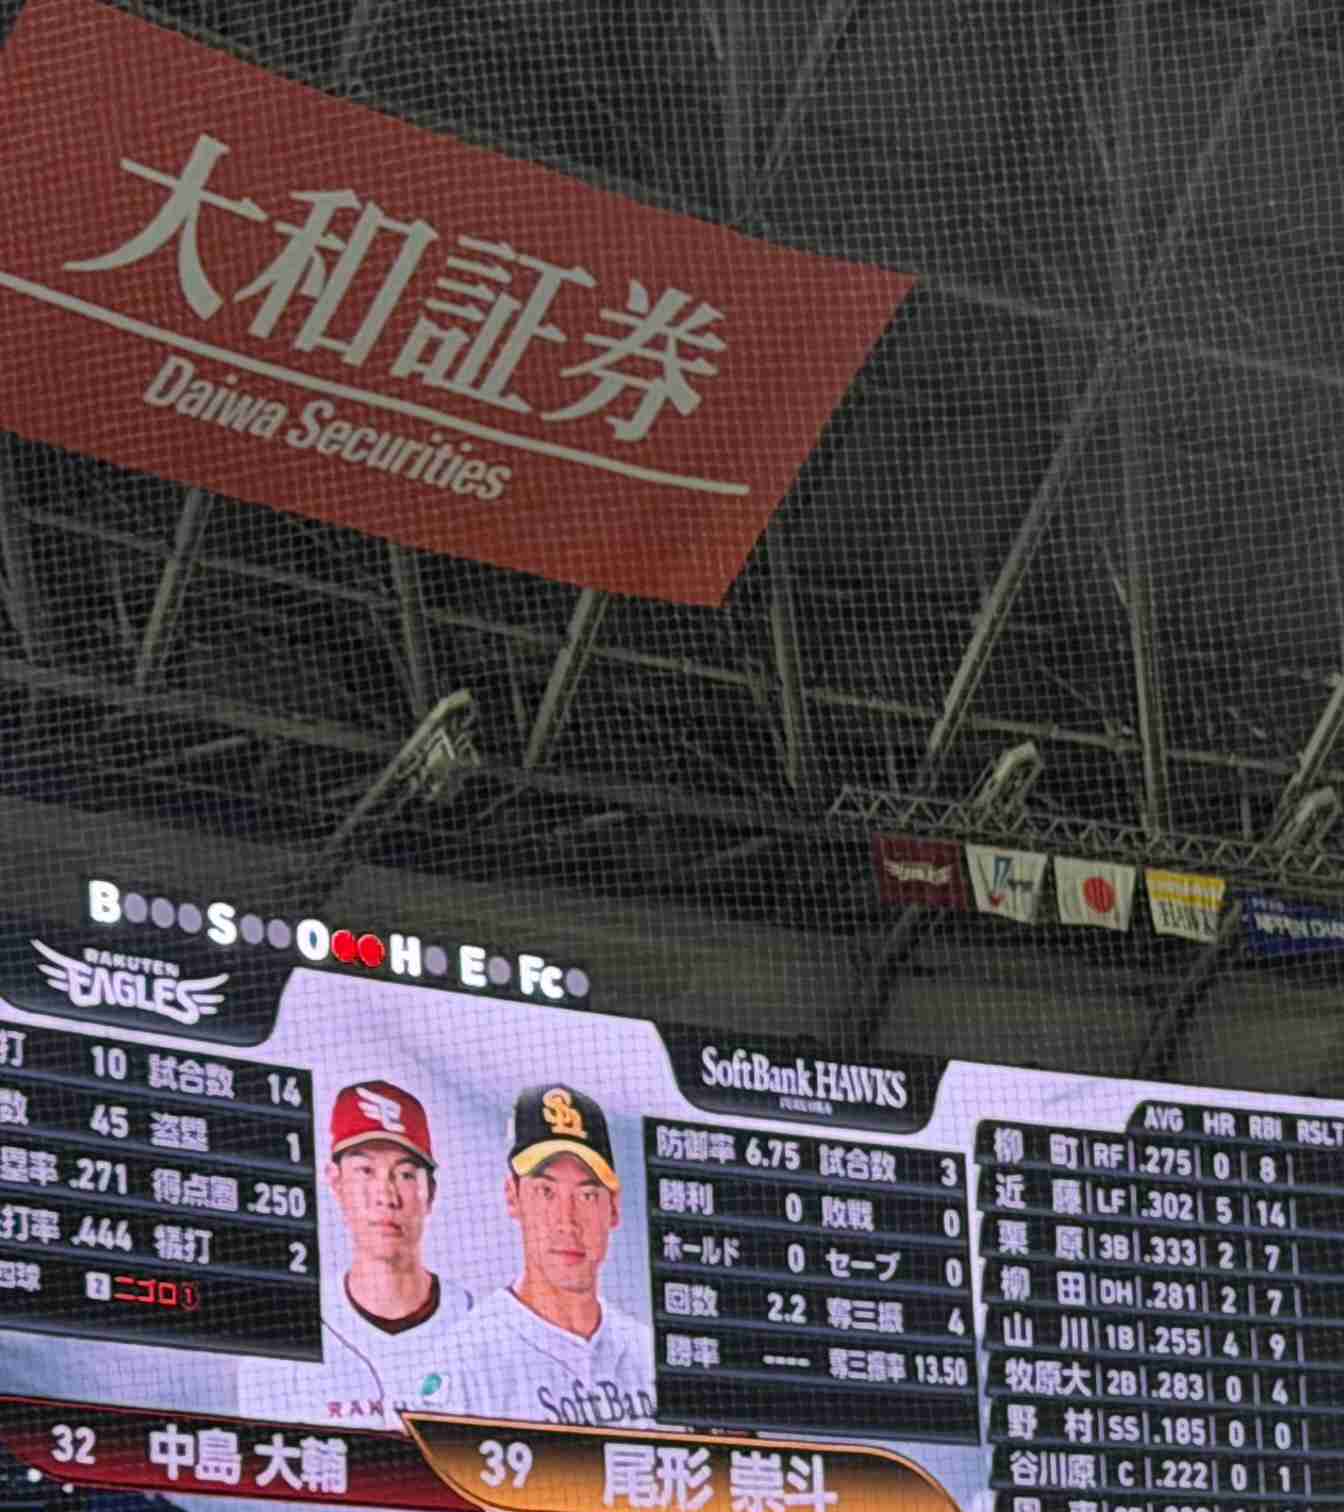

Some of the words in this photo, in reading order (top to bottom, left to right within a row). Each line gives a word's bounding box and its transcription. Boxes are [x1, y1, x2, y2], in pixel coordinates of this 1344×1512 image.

[62, 134, 727, 442] 大和証券
[143, 353, 287, 437] Daiwa
[287, 399, 512, 501] Securities
[89, 880, 121, 922] B
[207, 902, 238, 945] S
[298, 920, 330, 960] O
[391, 935, 422, 978] H
[460, 946, 487, 988] E
[58, 965, 205, 1025] EAGLES
[90, 1045, 127, 1080] 10
[267, 1073, 301, 1107] 14
[701, 1046, 814, 1098] SoftBank
[814, 1060, 907, 1109] HAWKS
[90, 1104, 129, 1138] 45
[1144, 1109, 1183, 1133] AVG
[1203, 1112, 1235, 1137] HR
[1249, 1116, 1282, 1142] RBI
[1297, 1119, 1344, 1146] RSLT
[745, 1138, 800, 1171] 6.75
[1094, 1143, 1124, 1168] RF
[1139, 1146, 1192, 1176] .275
[68, 1158, 128, 1195] .271
[247, 1182, 306, 1218] .250
[1096, 1188, 1126, 1214] LF
[1141, 1191, 1194, 1221] .302
[662, 1232, 741, 1267] ホールド
[1100, 1234, 1130, 1261] 3B
[1143, 1236, 1197, 1266] .333
[767, 1292, 808, 1324] 2.2
[1100, 1279, 1133, 1305] DH
[1146, 1282, 1197, 1310] .281
[1002, 1311, 1089, 1352] 山川
[1105, 1324, 1135, 1350] 1B
[1148, 1327, 1201, 1356] .255
[915, 1355, 969, 1387] 13.50
[1106, 1370, 1137, 1396] 2B
[1151, 1372, 1204, 1400] .283
[1108, 1415, 1141, 1442] SS
[1153, 1417, 1207, 1447] .185
[51, 1424, 96, 1465] 32
[150, 1423, 243, 1485] 中島
[254, 1434, 348, 1494] 大輔
[479, 1440, 533, 1488] 39
[602, 1442, 715, 1512] 尾形
[1118, 1461, 1134, 1488] C
[1155, 1460, 1209, 1489] .222
